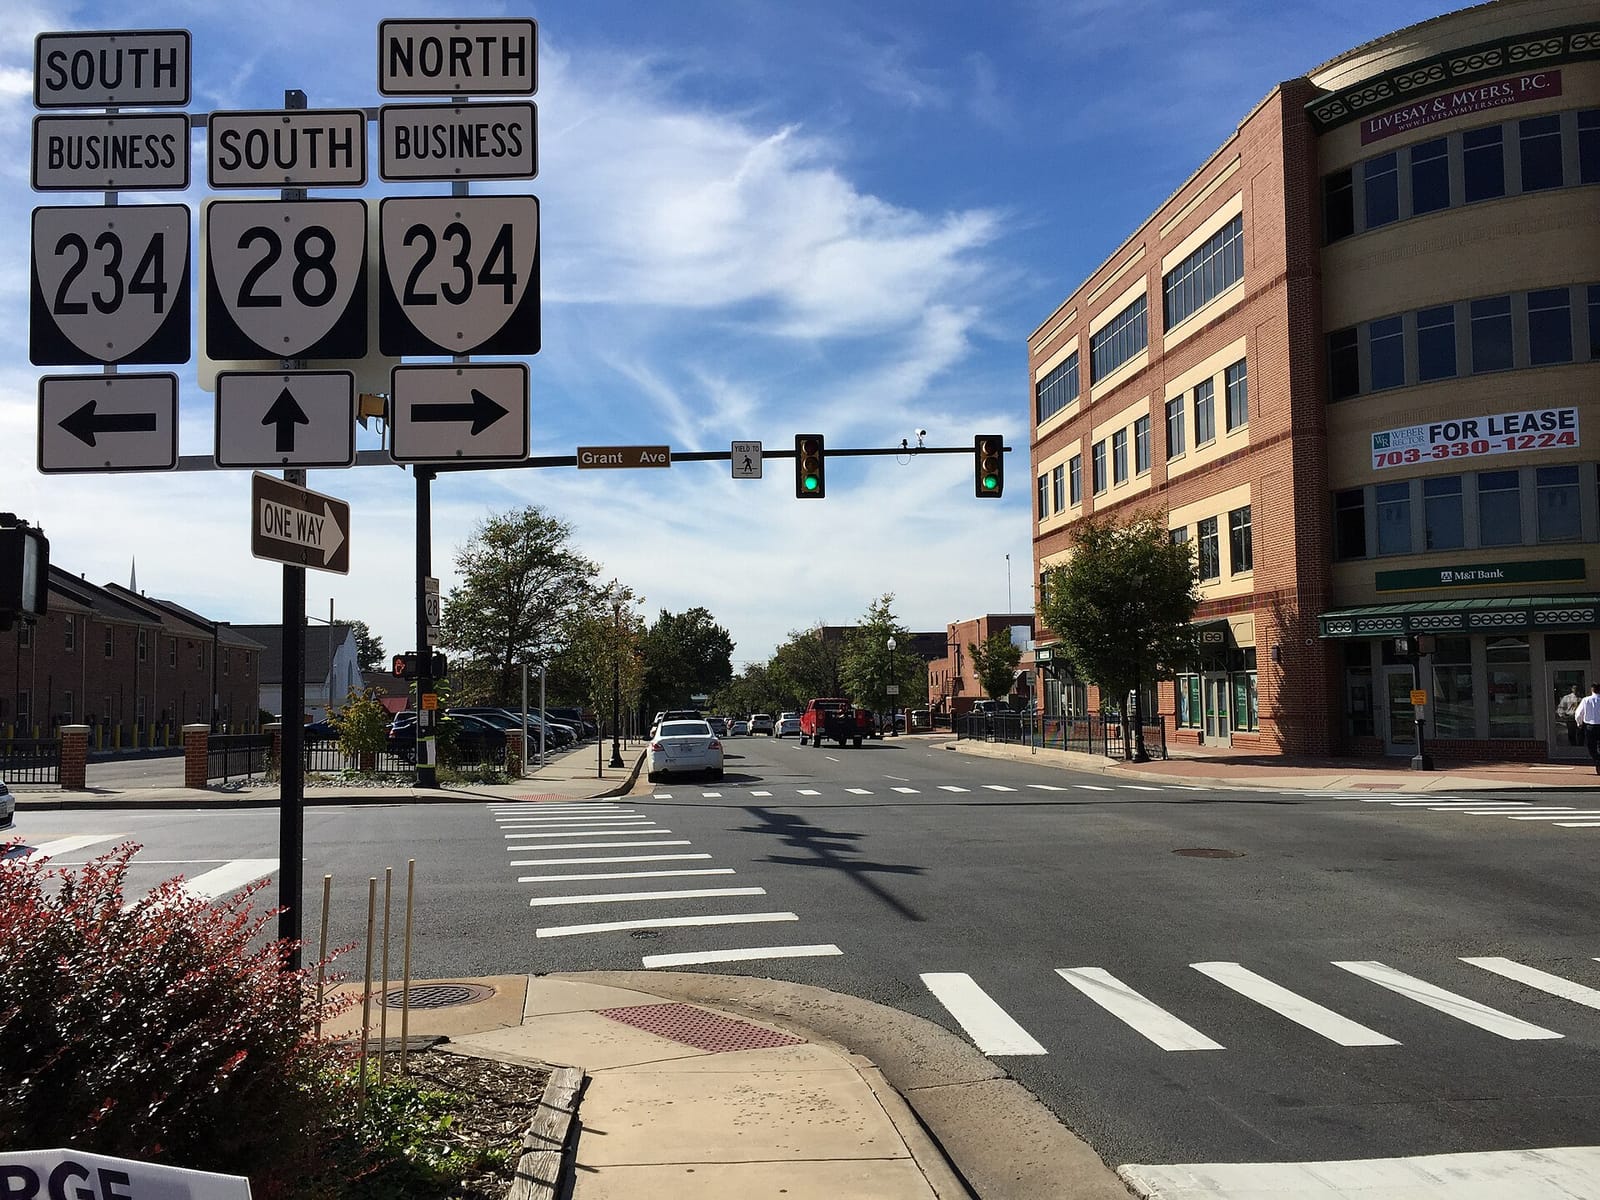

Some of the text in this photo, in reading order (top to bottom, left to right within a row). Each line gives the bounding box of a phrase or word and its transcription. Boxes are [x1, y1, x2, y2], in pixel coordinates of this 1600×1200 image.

[45, 47, 177, 91] SOUTH
[389, 36, 526, 78] NORTH
[1369, 74, 1550, 133] LIVESAY & MYERS, P.C.
[48, 133, 176, 170] BUSINESS
[218, 127, 353, 171] SOUTH
[394, 122, 523, 161] BUSINESS
[53, 231, 168, 315] 234
[236, 225, 338, 308] 28
[401, 222, 518, 306] 234
[1391, 427, 1425, 440] WEBER
[1392, 436, 1425, 447] RECTOR
[1429, 410, 1575, 443] FOR LEASE
[581, 450, 666, 464] Grant Ave
[1374, 431, 1577, 468] 703-330-1224
[264, 503, 325, 546] ONE WAY
[1454, 568, 1504, 580] M&T Bank
[428, 600, 438, 616] 28
